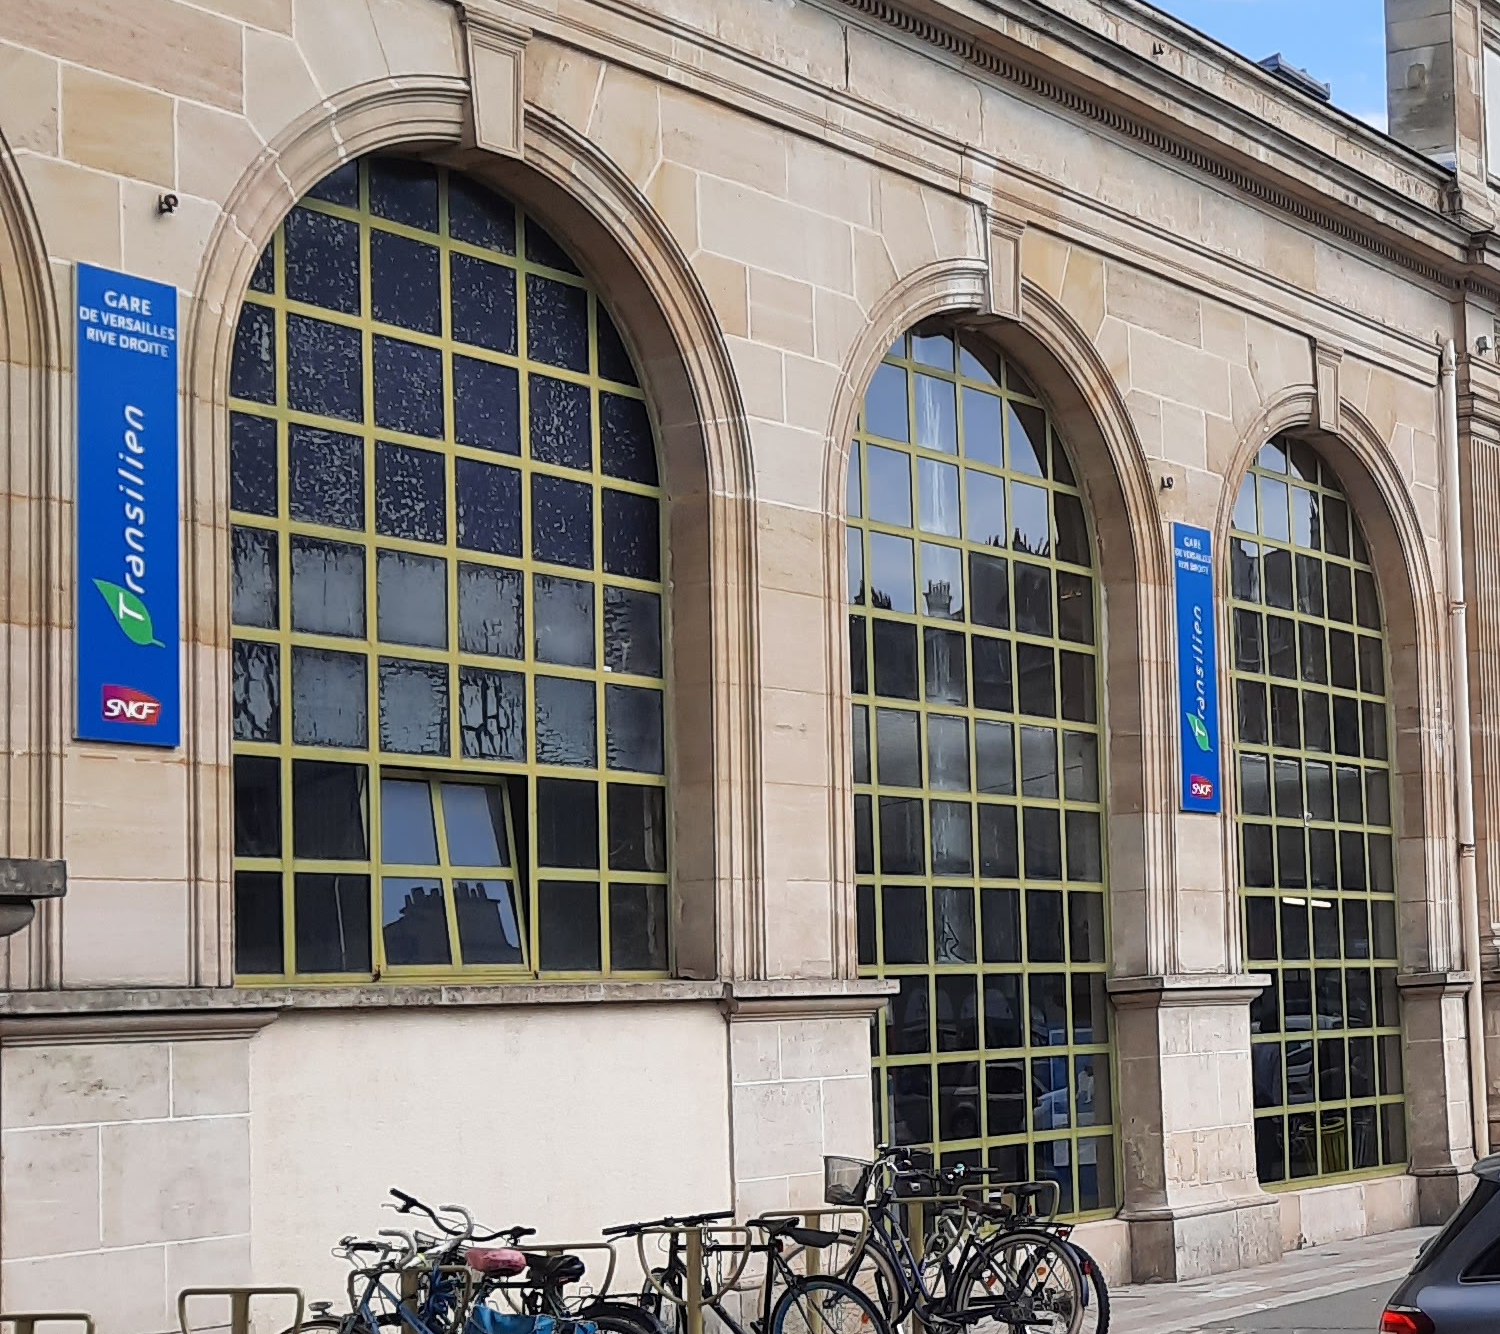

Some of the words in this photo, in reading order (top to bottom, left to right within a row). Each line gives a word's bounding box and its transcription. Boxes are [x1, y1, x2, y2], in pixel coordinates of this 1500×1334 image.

[104, 290, 152, 316] GARE
[80, 306, 99, 323] DE
[101, 311, 175, 341] VERSAILLES
[87, 326, 117, 346] RIVE
[119, 334, 169, 358] DROITE
[118, 404, 145, 621] Transilien
[1191, 605, 1206, 737] Transilien
[104, 699, 160, 717] SNCF
[1191, 783, 1213, 795] SNCF
